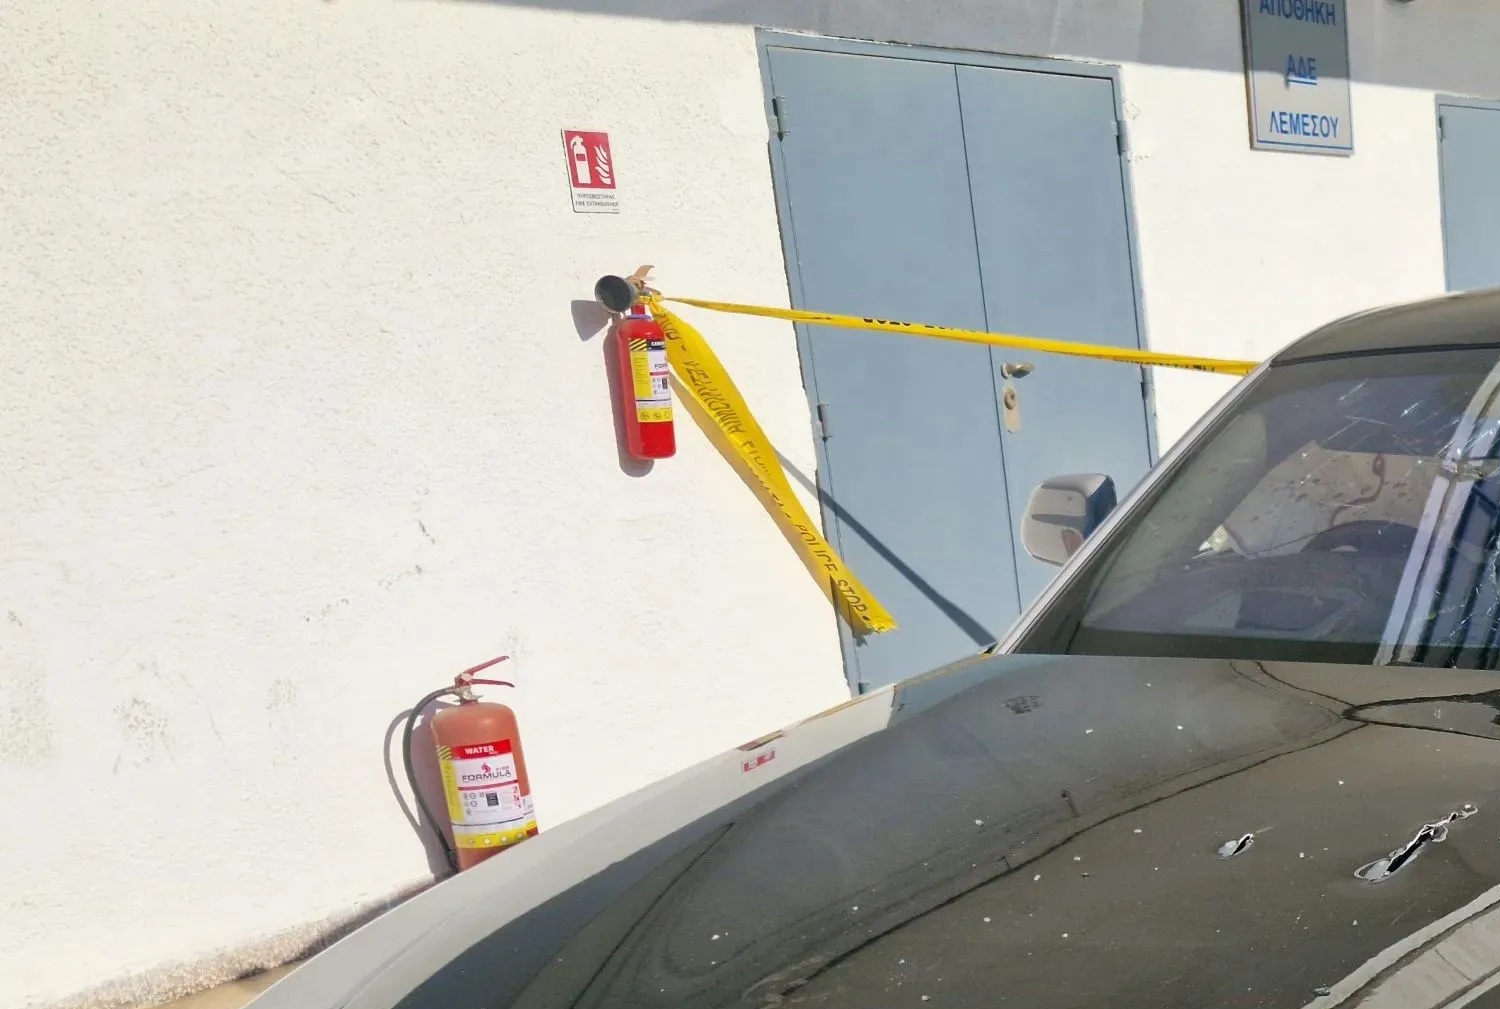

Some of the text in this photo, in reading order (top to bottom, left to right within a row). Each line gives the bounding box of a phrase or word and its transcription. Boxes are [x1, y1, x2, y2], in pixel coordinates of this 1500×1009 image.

[1260, 0, 1336, 26] ΑΠΟΘΗΚΗ
[1287, 54, 1317, 80] ΑΔΕ
[1269, 111, 1339, 138] ΛΕΜΕΣΟΥ
[465, 745, 495, 755] WATER
[461, 769, 512, 782] FORMULA
